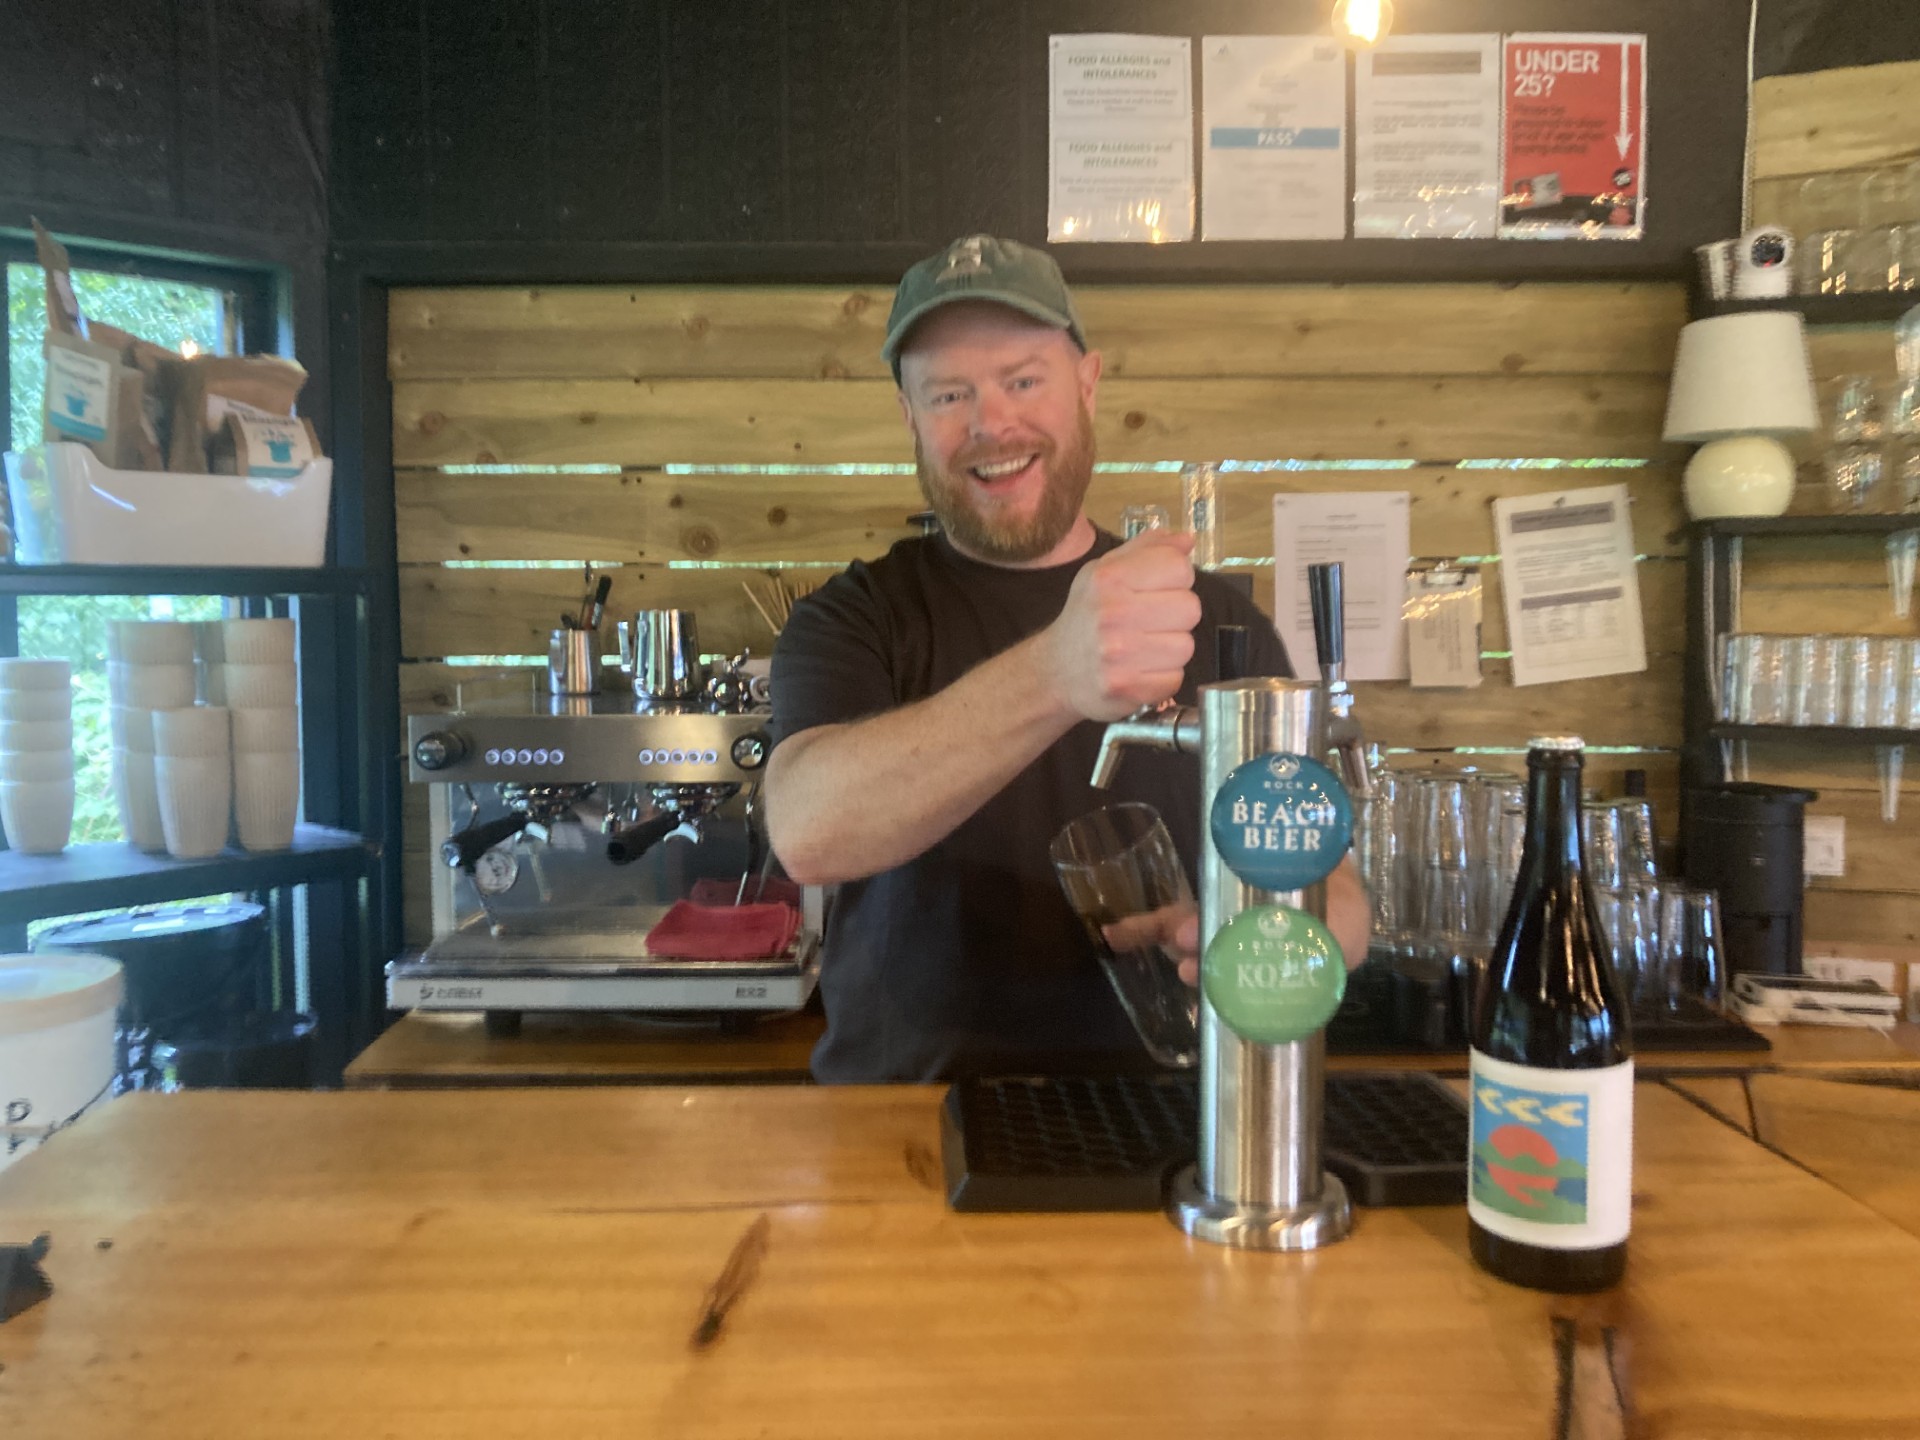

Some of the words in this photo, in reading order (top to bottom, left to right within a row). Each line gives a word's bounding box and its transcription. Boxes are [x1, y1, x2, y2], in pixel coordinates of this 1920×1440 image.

[1068, 54, 1098, 65] FOOD
[1153, 55, 1172, 66] and
[1514, 48, 1600, 74] UNDER
[1083, 67, 1158, 80] INTOLERANCES
[1514, 73, 1556, 98] 25?
[1257, 130, 1294, 147] PASS
[1069, 142, 1098, 153] FOOD
[1154, 142, 1173, 153] and
[1263, 780, 1304, 790] ROCK
[1232, 802, 1336, 827] BEACH
[1243, 826, 1321, 851] BEER
